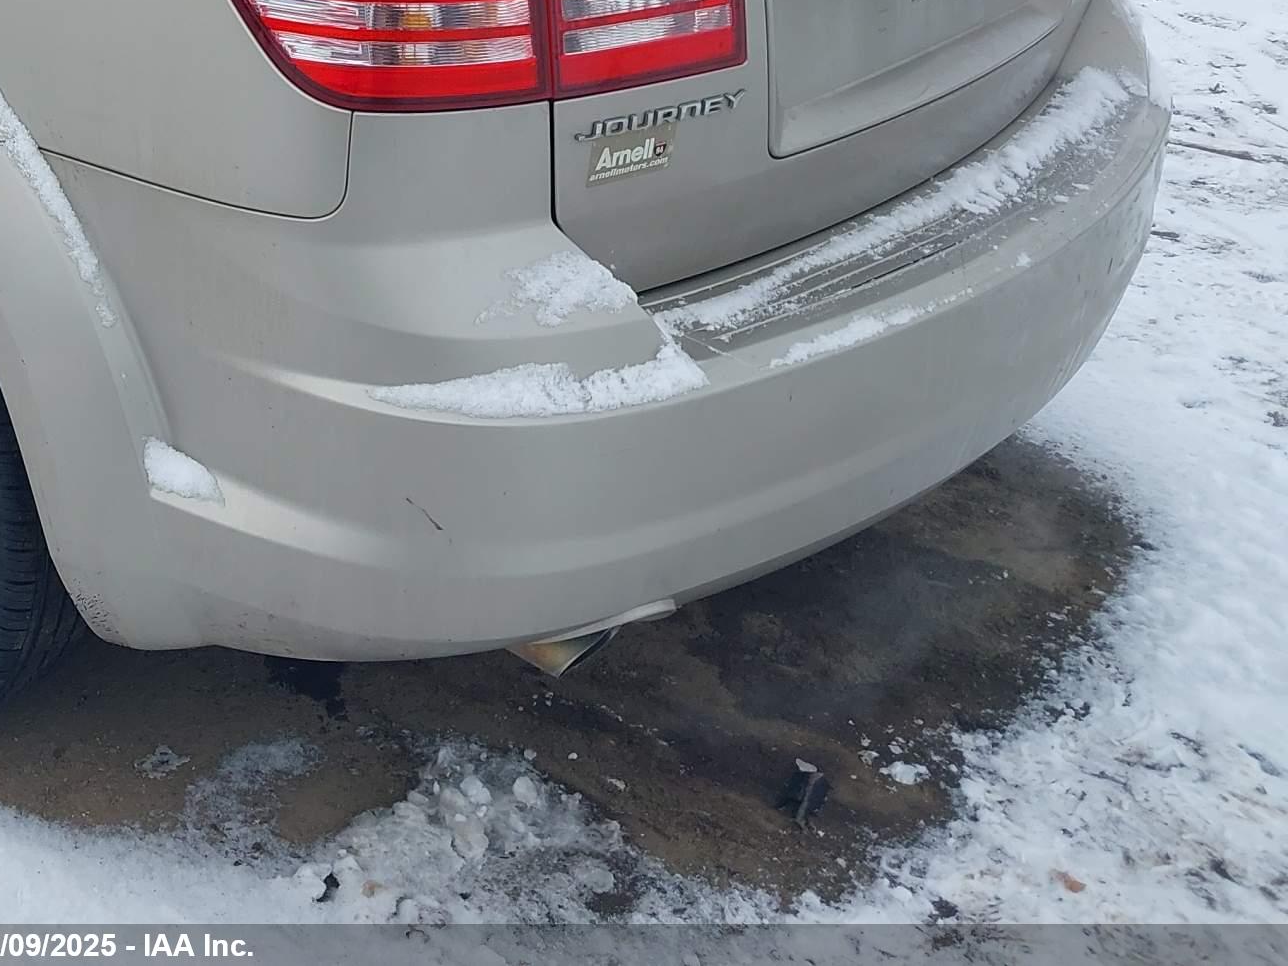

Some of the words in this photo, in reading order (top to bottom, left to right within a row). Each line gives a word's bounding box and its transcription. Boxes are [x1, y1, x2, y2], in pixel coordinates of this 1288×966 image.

[575, 89, 747, 142] JOURNEY
[589, 156, 669, 182] arnellmotors.com
[594, 137, 655, 171] Arnell
